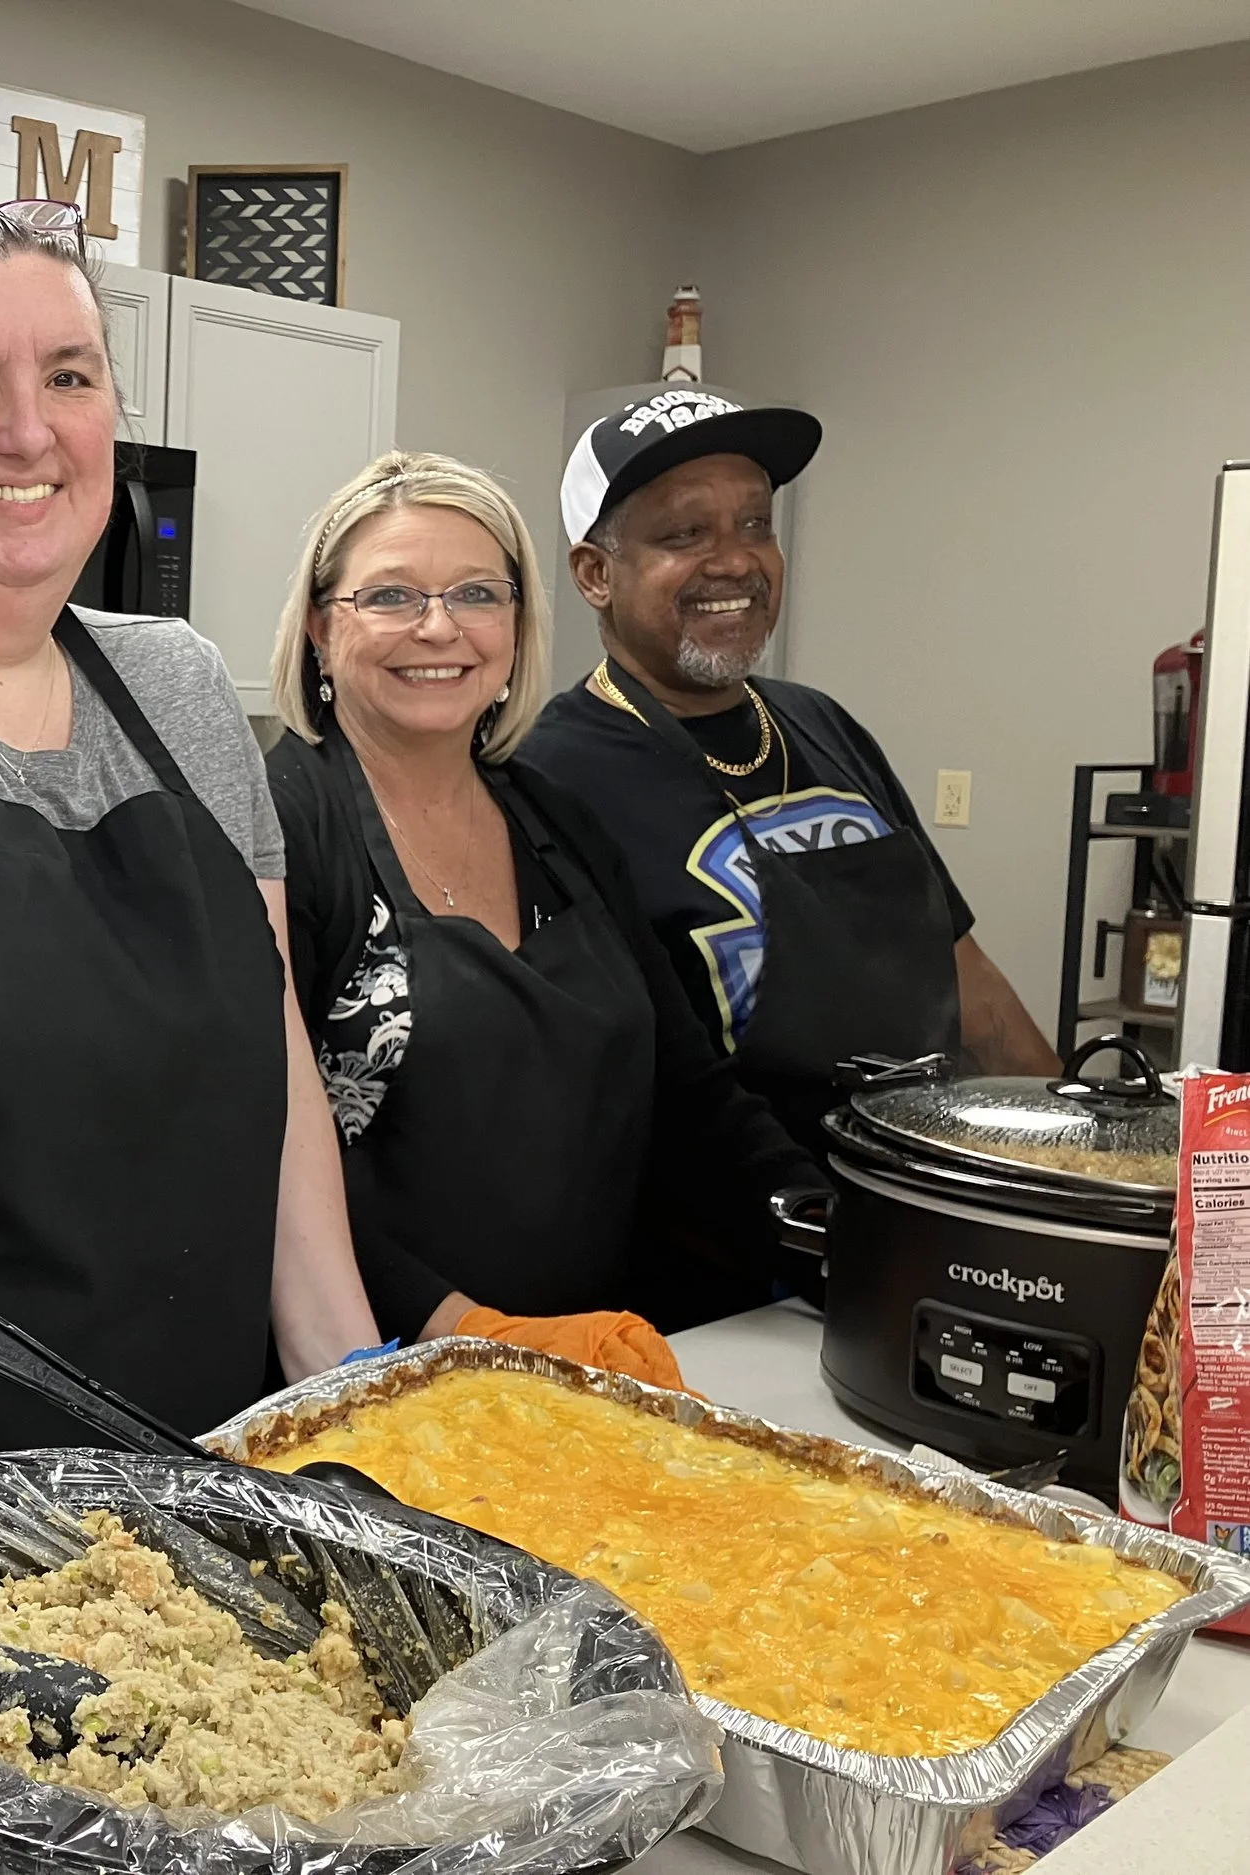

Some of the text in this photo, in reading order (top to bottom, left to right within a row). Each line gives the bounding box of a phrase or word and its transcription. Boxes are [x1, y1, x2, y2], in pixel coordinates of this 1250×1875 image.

[1207, 1084, 1250, 1114] Fren
[1195, 1198, 1245, 1209] Calories
[948, 1263, 1065, 1303] crockpot
